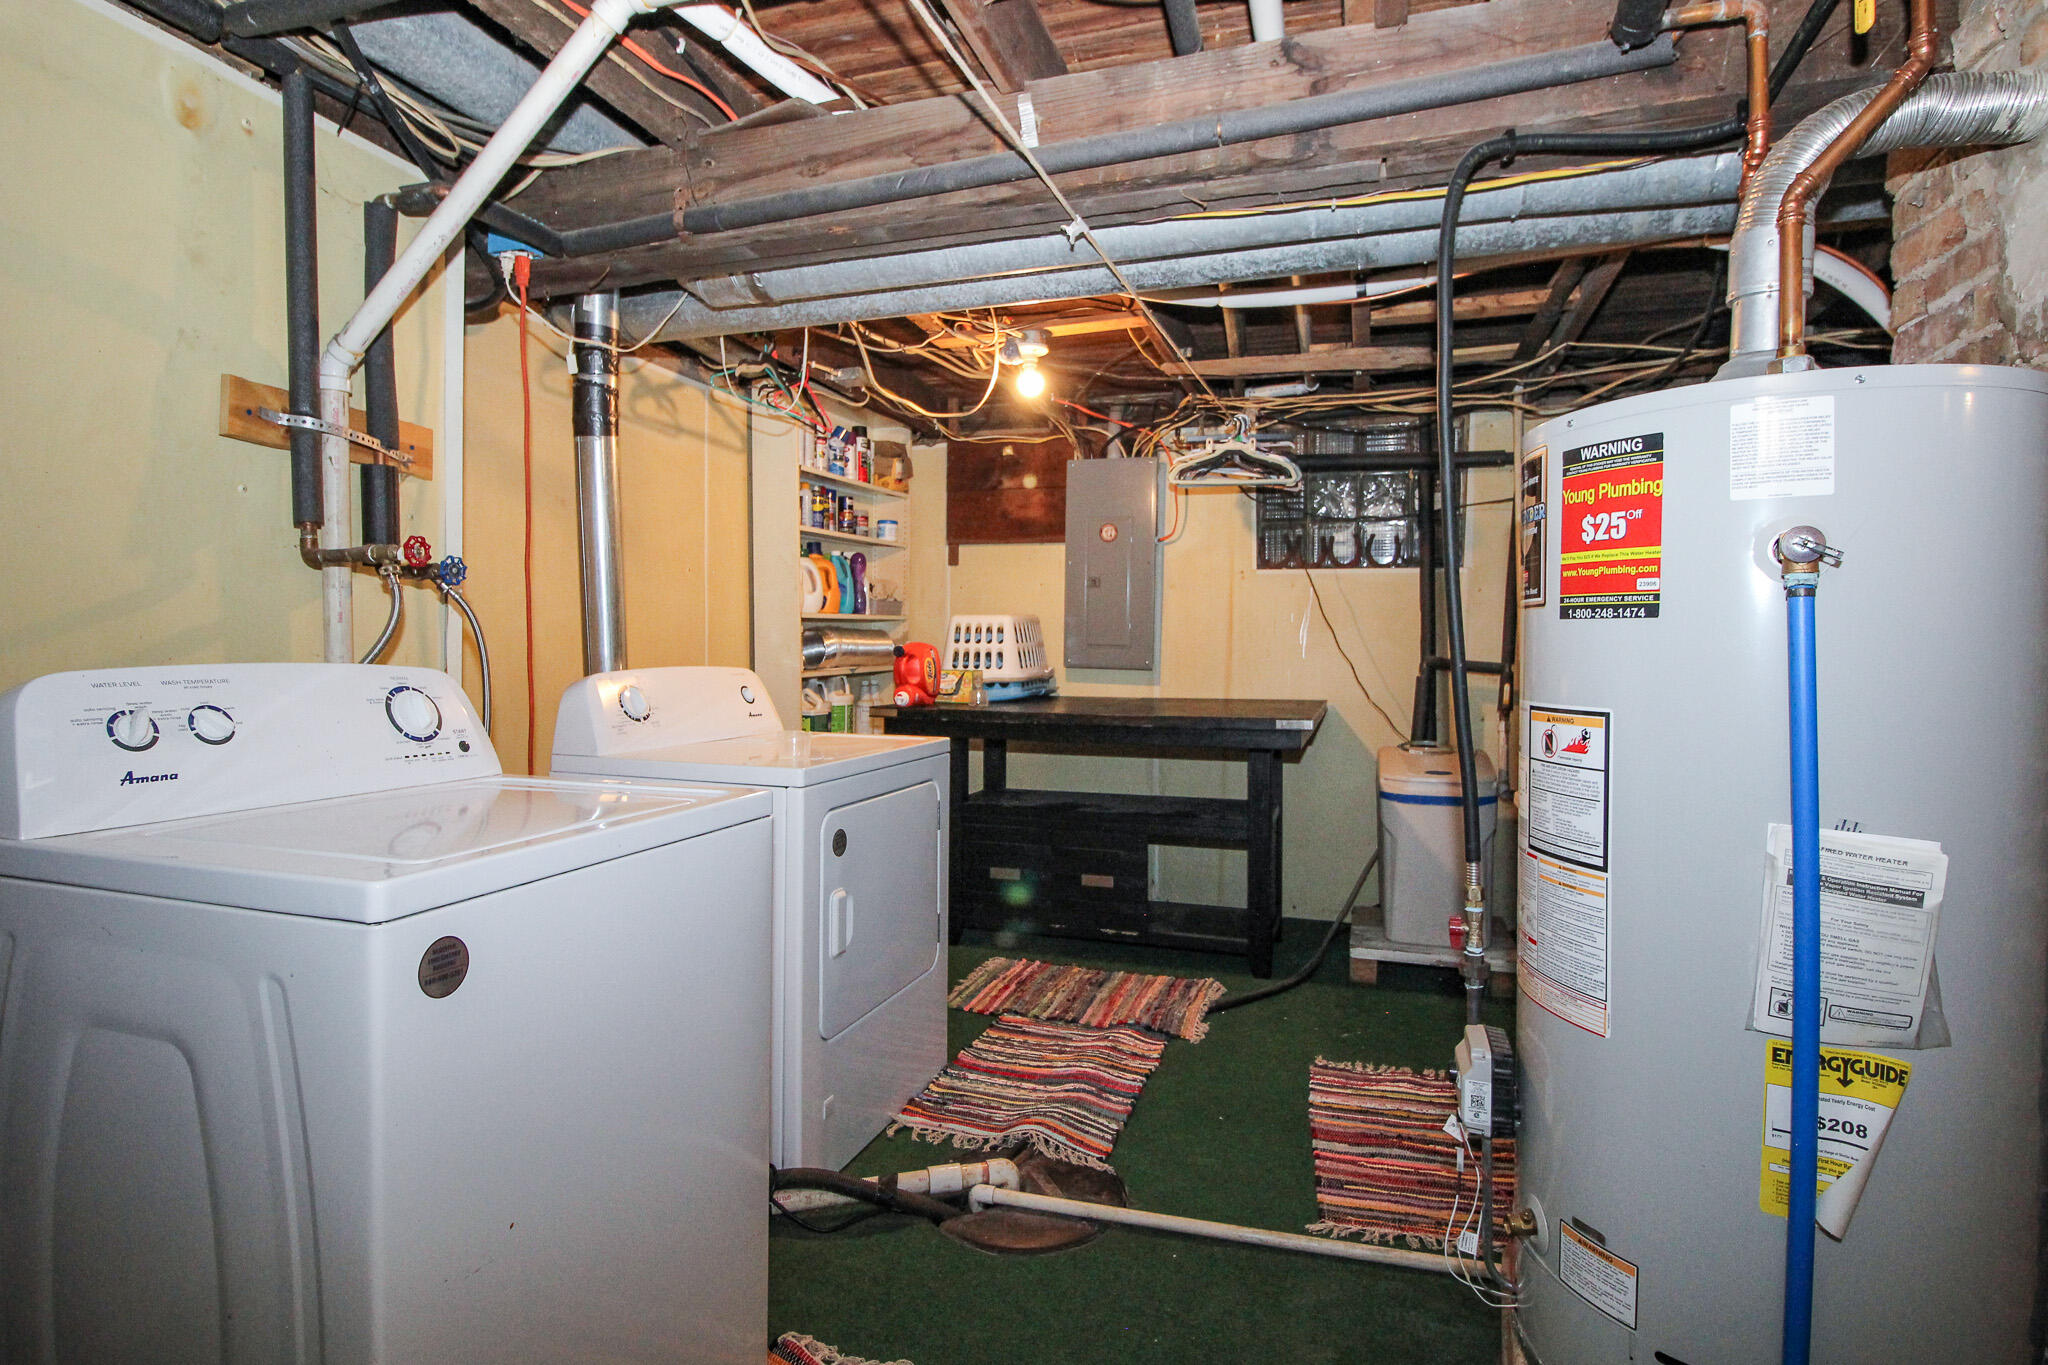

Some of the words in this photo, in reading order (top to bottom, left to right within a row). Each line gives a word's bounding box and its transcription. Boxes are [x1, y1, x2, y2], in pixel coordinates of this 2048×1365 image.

[1580, 438, 1643, 461] WARNING
[1562, 489, 1595, 507] Young
[1599, 477, 1663, 502] Plumbing
[1581, 513, 1627, 544] $25
[1626, 509, 1644, 521] Off
[1562, 565, 1658, 577] www.YoungPlumbing.com
[1568, 607, 1646, 619] 1-800-248-1474
[119, 680, 142, 688] LEVEL
[120, 770, 178, 786] Amana
[1845, 851, 1873, 862] WATER
[1875, 856, 1909, 867] HEATER
[1772, 1046, 1909, 1087] ENRGYGUIDE
[1846, 1100, 1864, 1110] Energy
[1864, 1103, 1876, 1112] Cost
[1817, 1115, 1868, 1139] $208
[1582, 1237, 1614, 1264] WARNING
